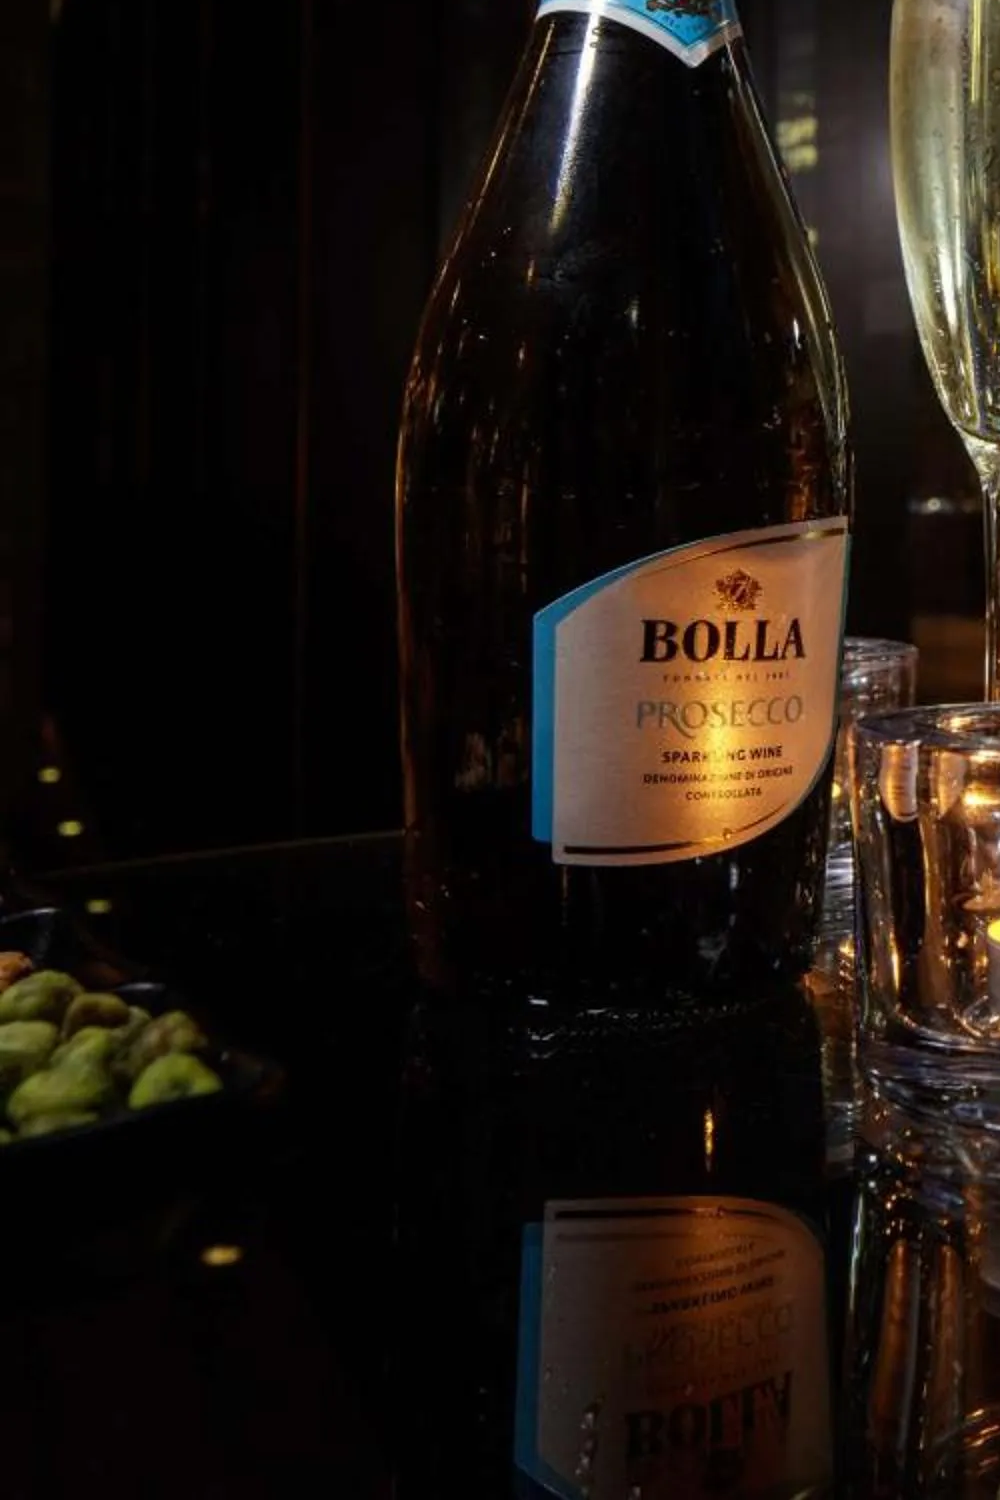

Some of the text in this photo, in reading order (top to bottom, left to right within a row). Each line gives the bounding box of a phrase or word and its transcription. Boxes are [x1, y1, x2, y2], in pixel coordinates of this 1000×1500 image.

[640, 618, 806, 662] BOLLA
[636, 694, 803, 739] PROSECCO
[661, 745, 783, 763] SPARKNG WINE
